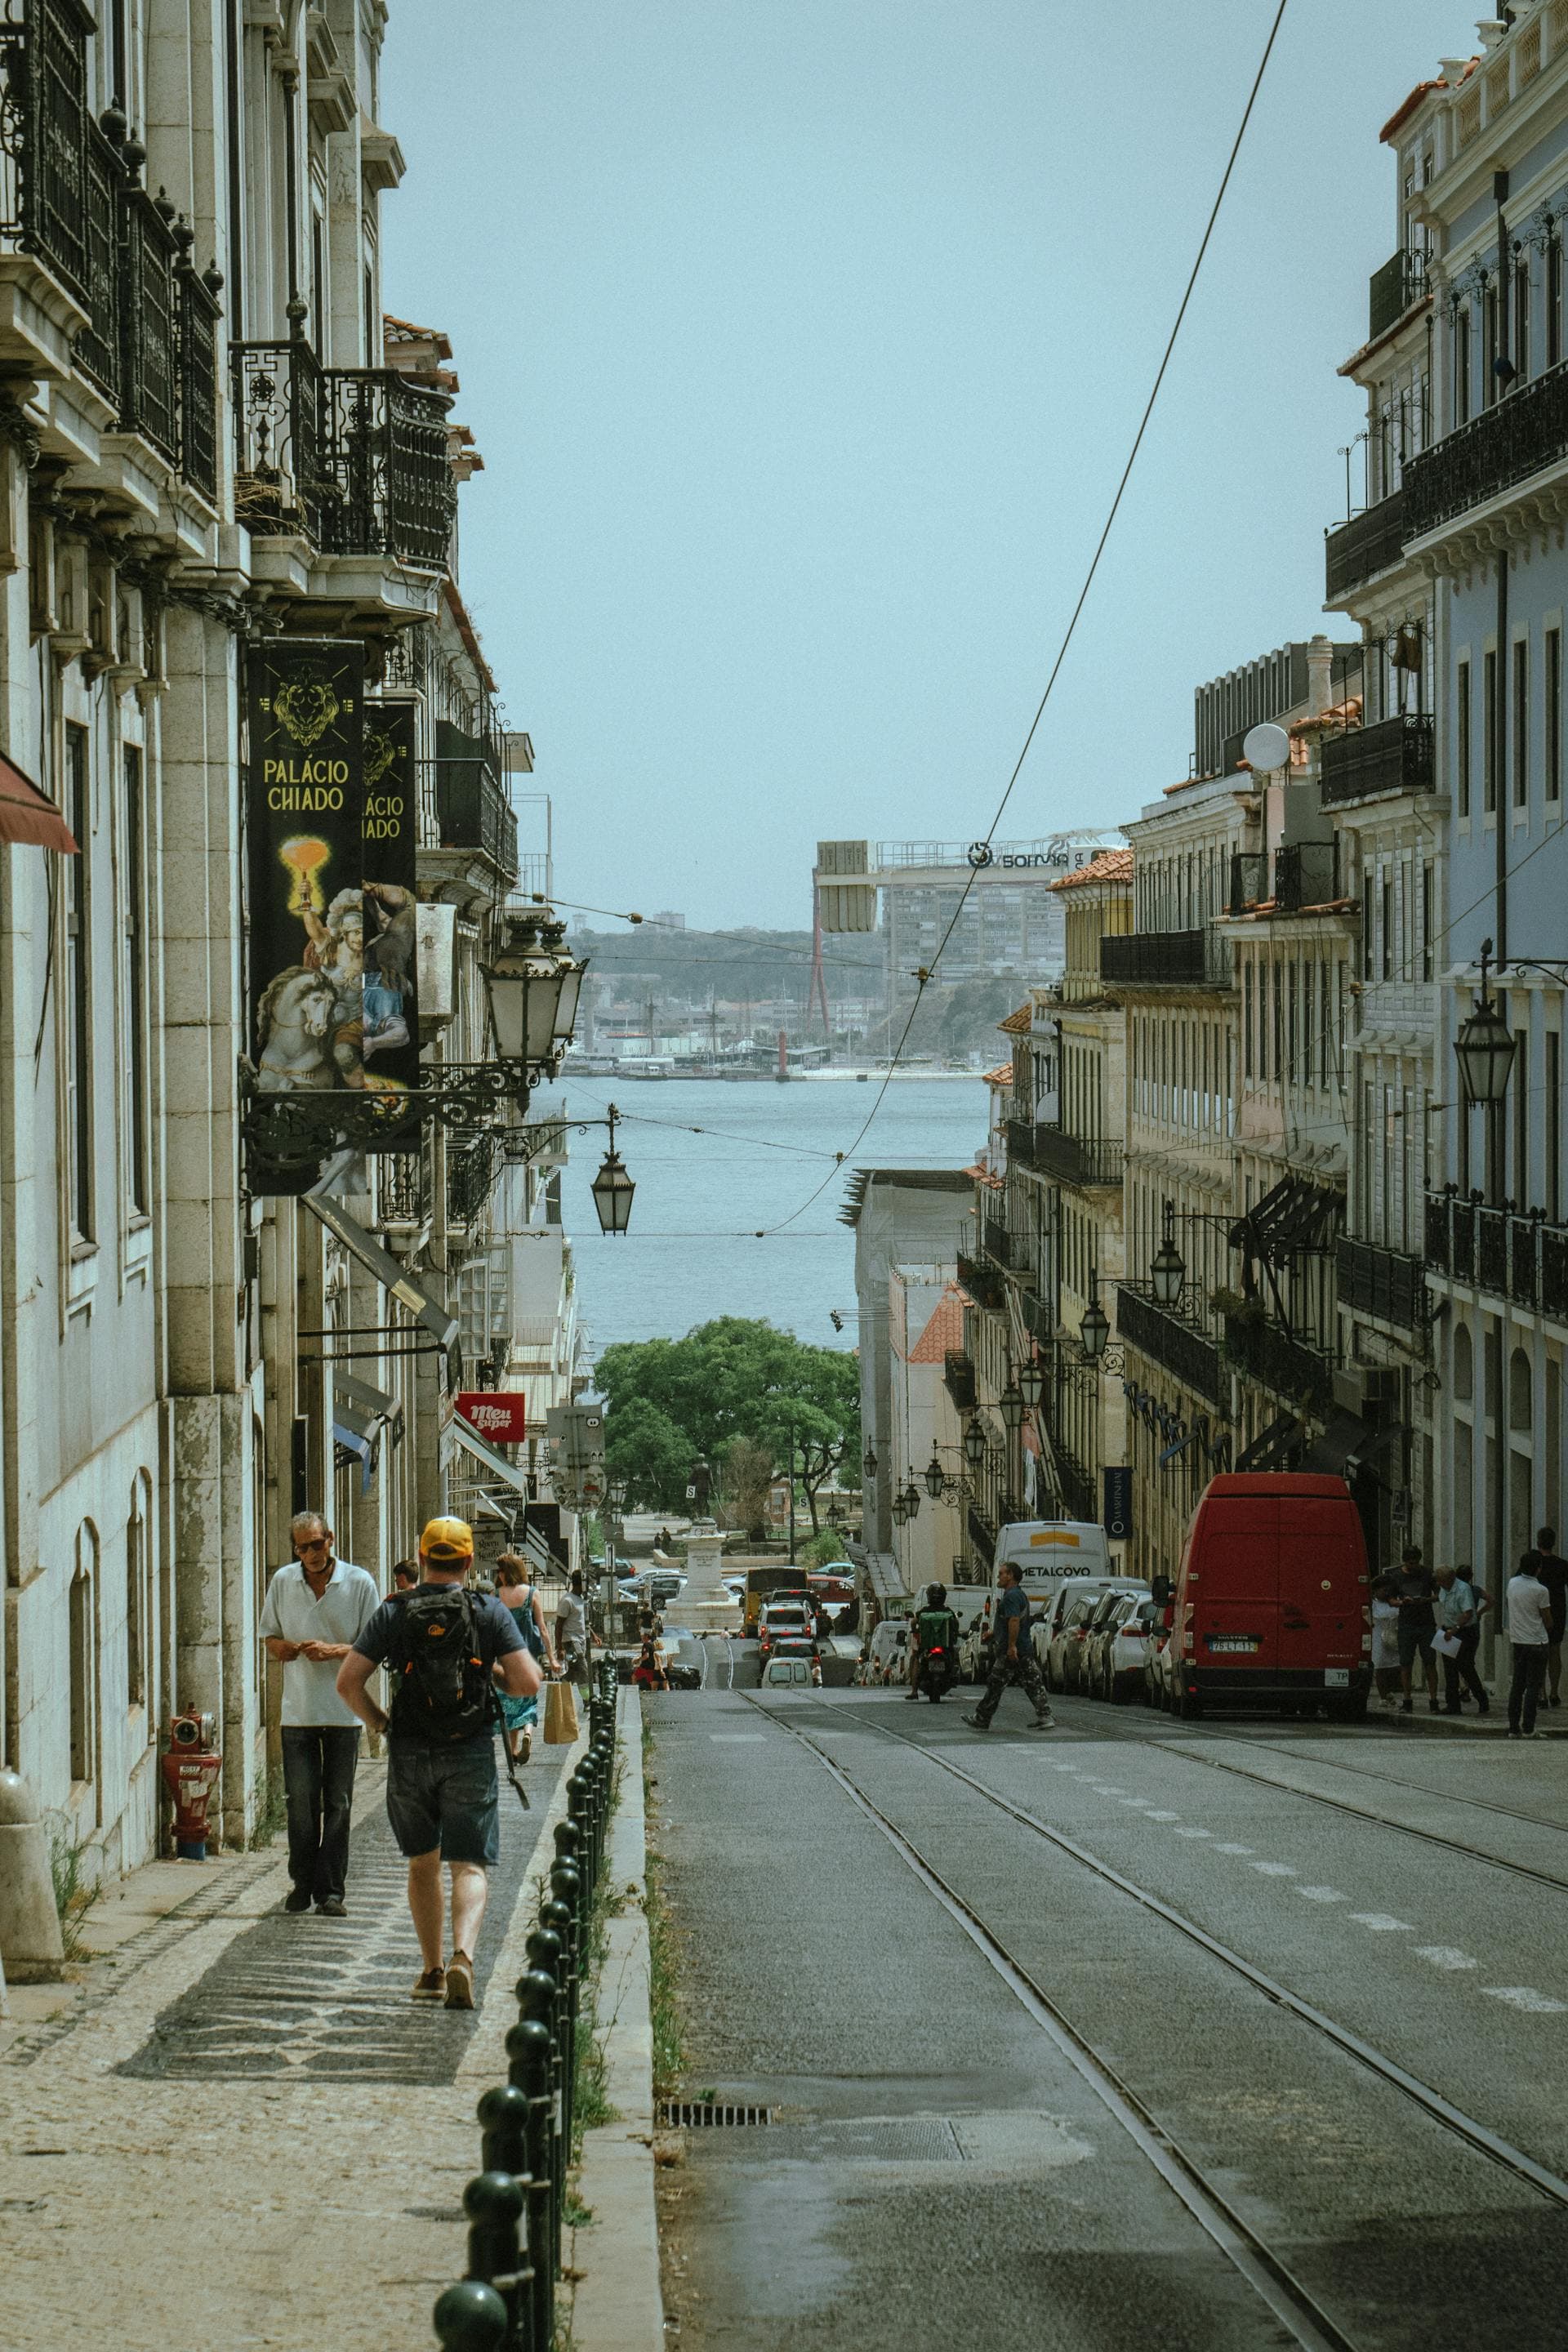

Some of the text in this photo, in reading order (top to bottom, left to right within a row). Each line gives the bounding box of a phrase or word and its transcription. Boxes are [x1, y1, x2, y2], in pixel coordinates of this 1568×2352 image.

[264, 754, 349, 783] PALÁCIO
[268, 787, 343, 810] CHIADO
[362, 791, 403, 816] ÁCIO
[470, 1405, 511, 1420] Meu
[476, 1419, 512, 1431] super
[688, 1487, 693, 1496] S
[800, 1498, 807, 1508] S
[1336, 1672, 1348, 1681] TP
